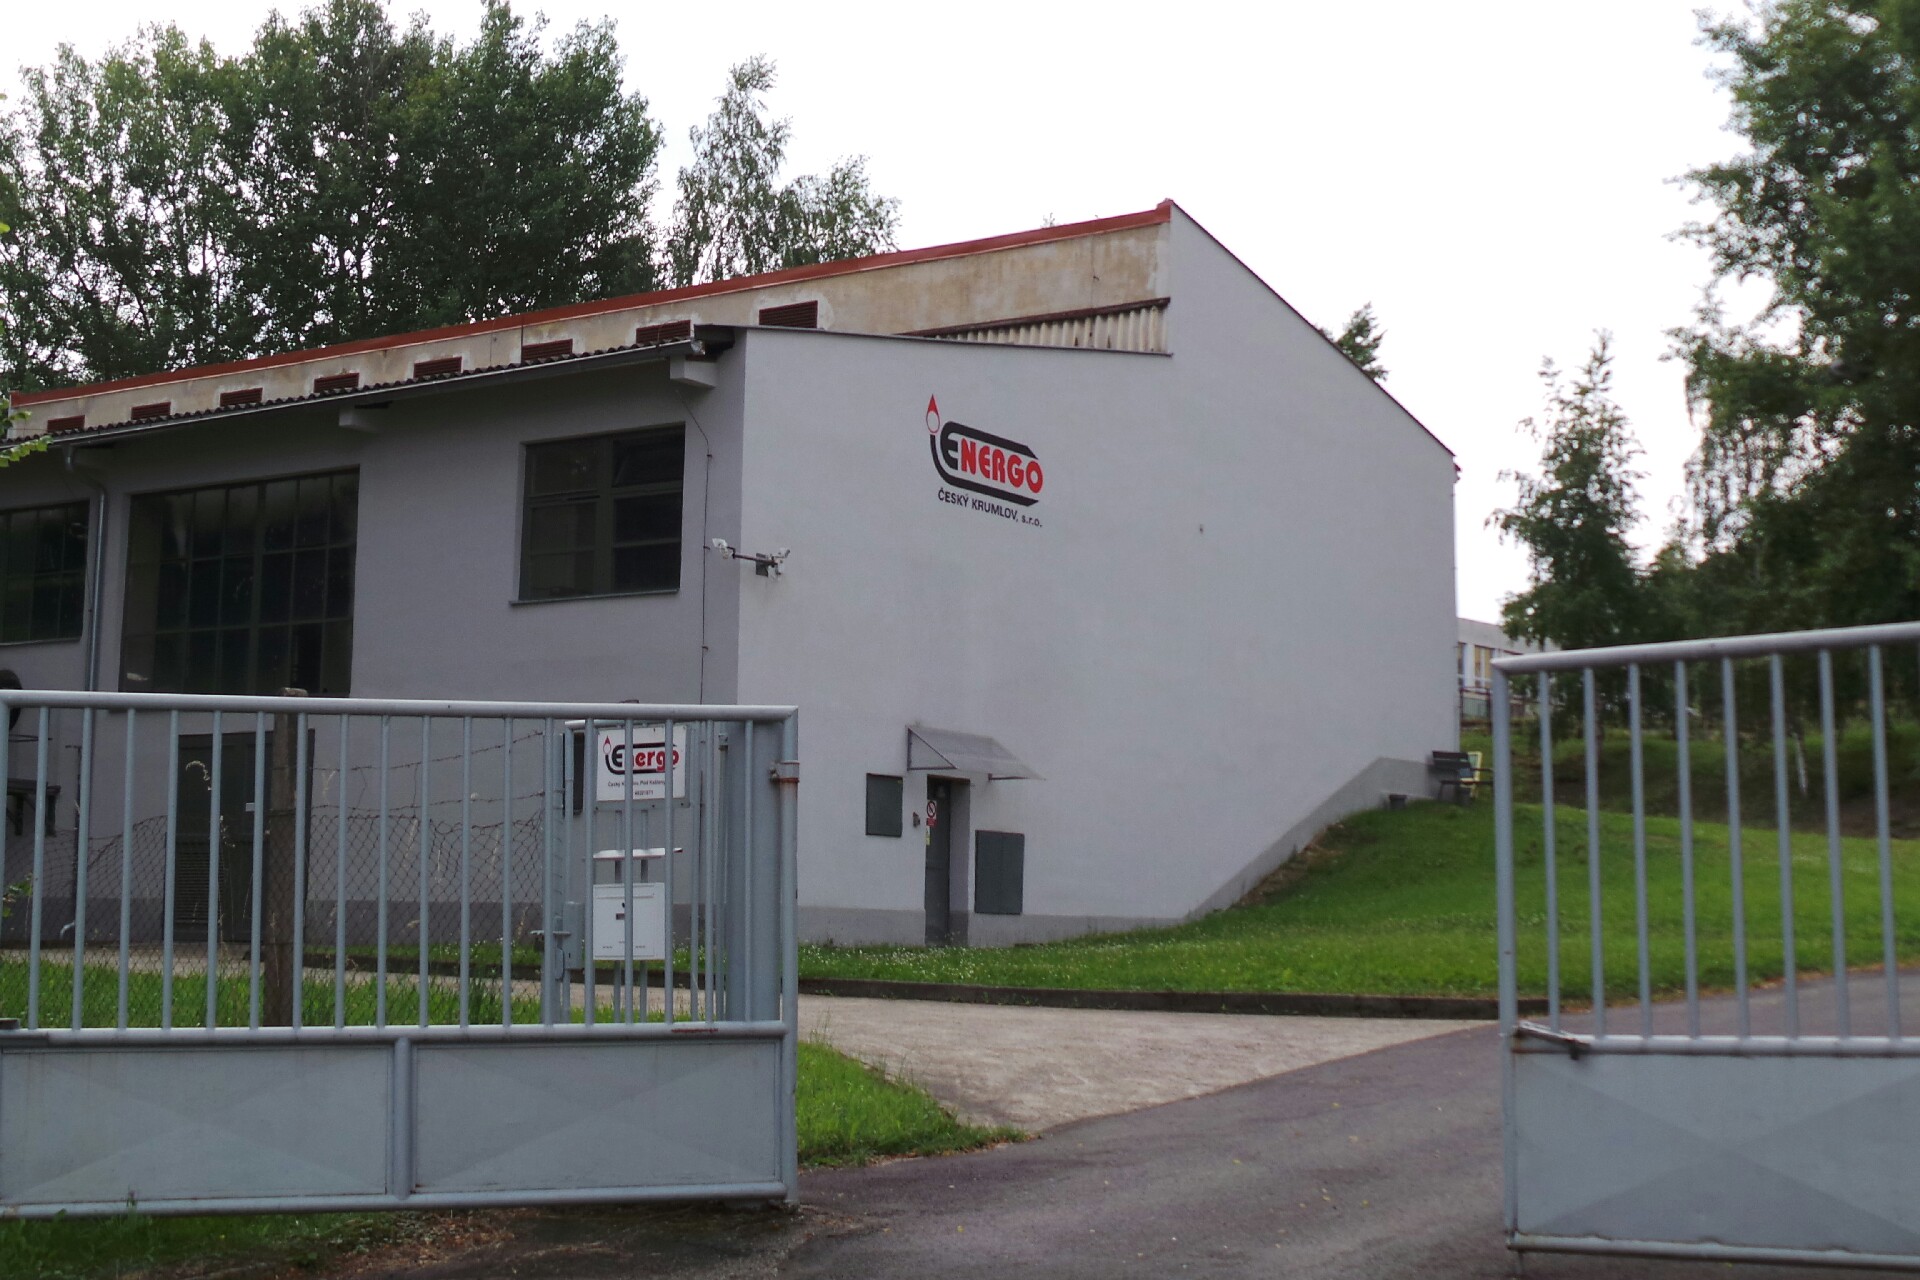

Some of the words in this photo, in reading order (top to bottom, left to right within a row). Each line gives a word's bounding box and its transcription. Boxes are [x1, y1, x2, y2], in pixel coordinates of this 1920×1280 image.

[940, 421, 1043, 494] ENERGO
[937, 487, 969, 507] ČESKÝ
[971, 498, 1019, 522] KRUMLOV,
[1021, 515, 1043, 527] s.r.o.
[612, 744, 679, 772] Eergo
